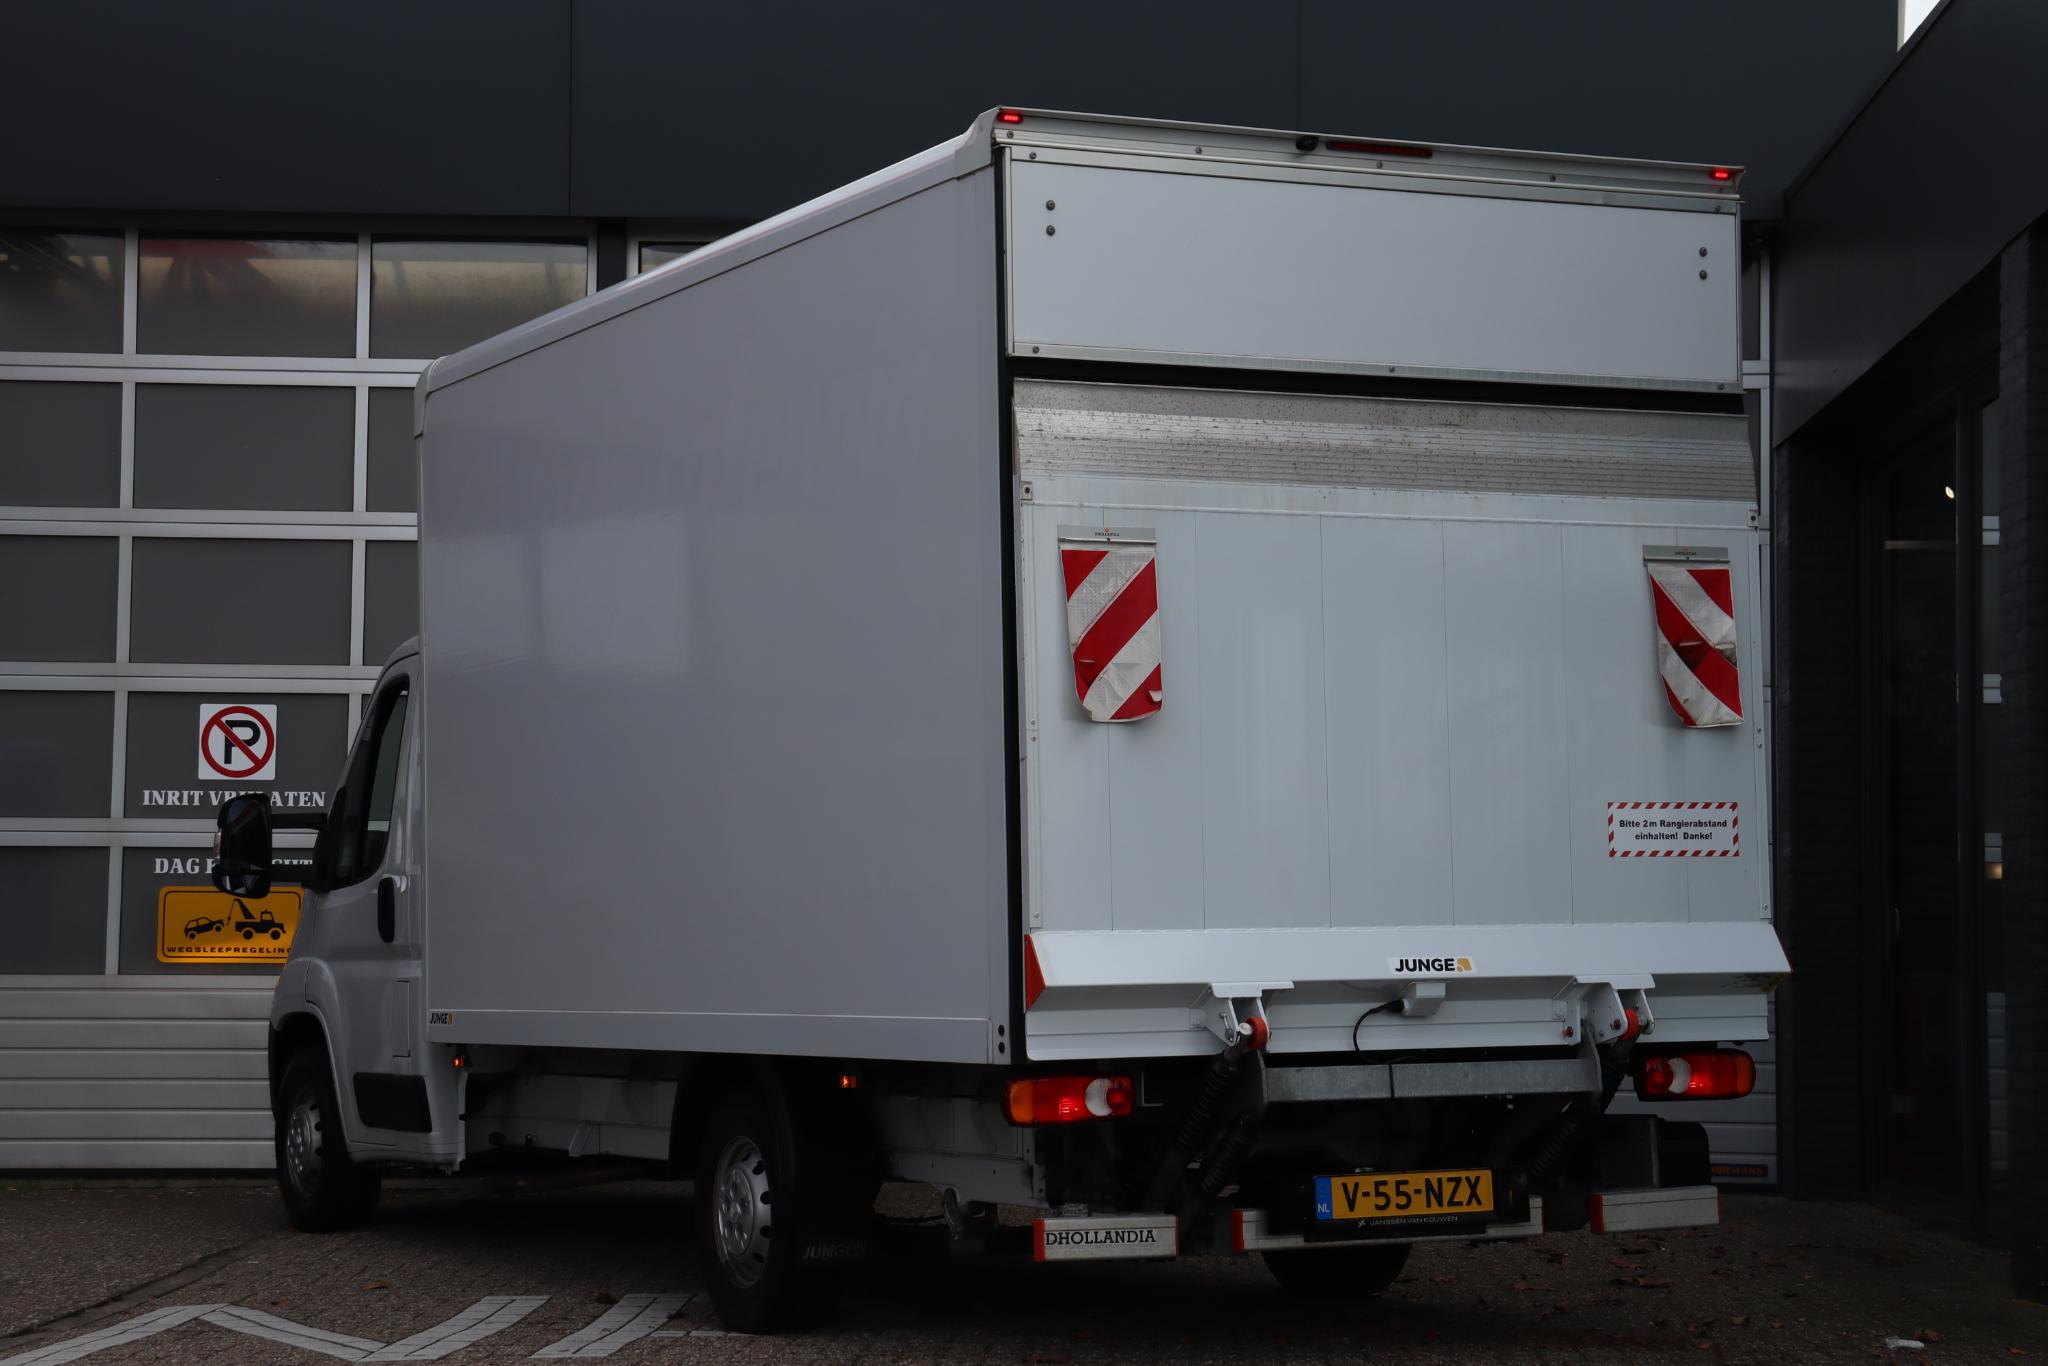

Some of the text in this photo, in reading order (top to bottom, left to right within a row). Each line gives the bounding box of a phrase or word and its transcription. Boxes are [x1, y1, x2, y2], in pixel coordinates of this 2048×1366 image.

[142, 789, 204, 806] INRIT
[1619, 820, 1641, 828] Bitte
[1659, 820, 1727, 829] Rangierabstand
[1635, 832, 1712, 840] einhalten! Danke!
[153, 857, 201, 875] DAG
[1395, 958, 1455, 972] JUNGE
[430, 1012, 448, 1025] JUNGE
[1341, 1175, 1483, 1213] V-55-NZX
[1317, 1203, 1331, 1213] NL
[1045, 1229, 1156, 1246] DHOLLANDIA
